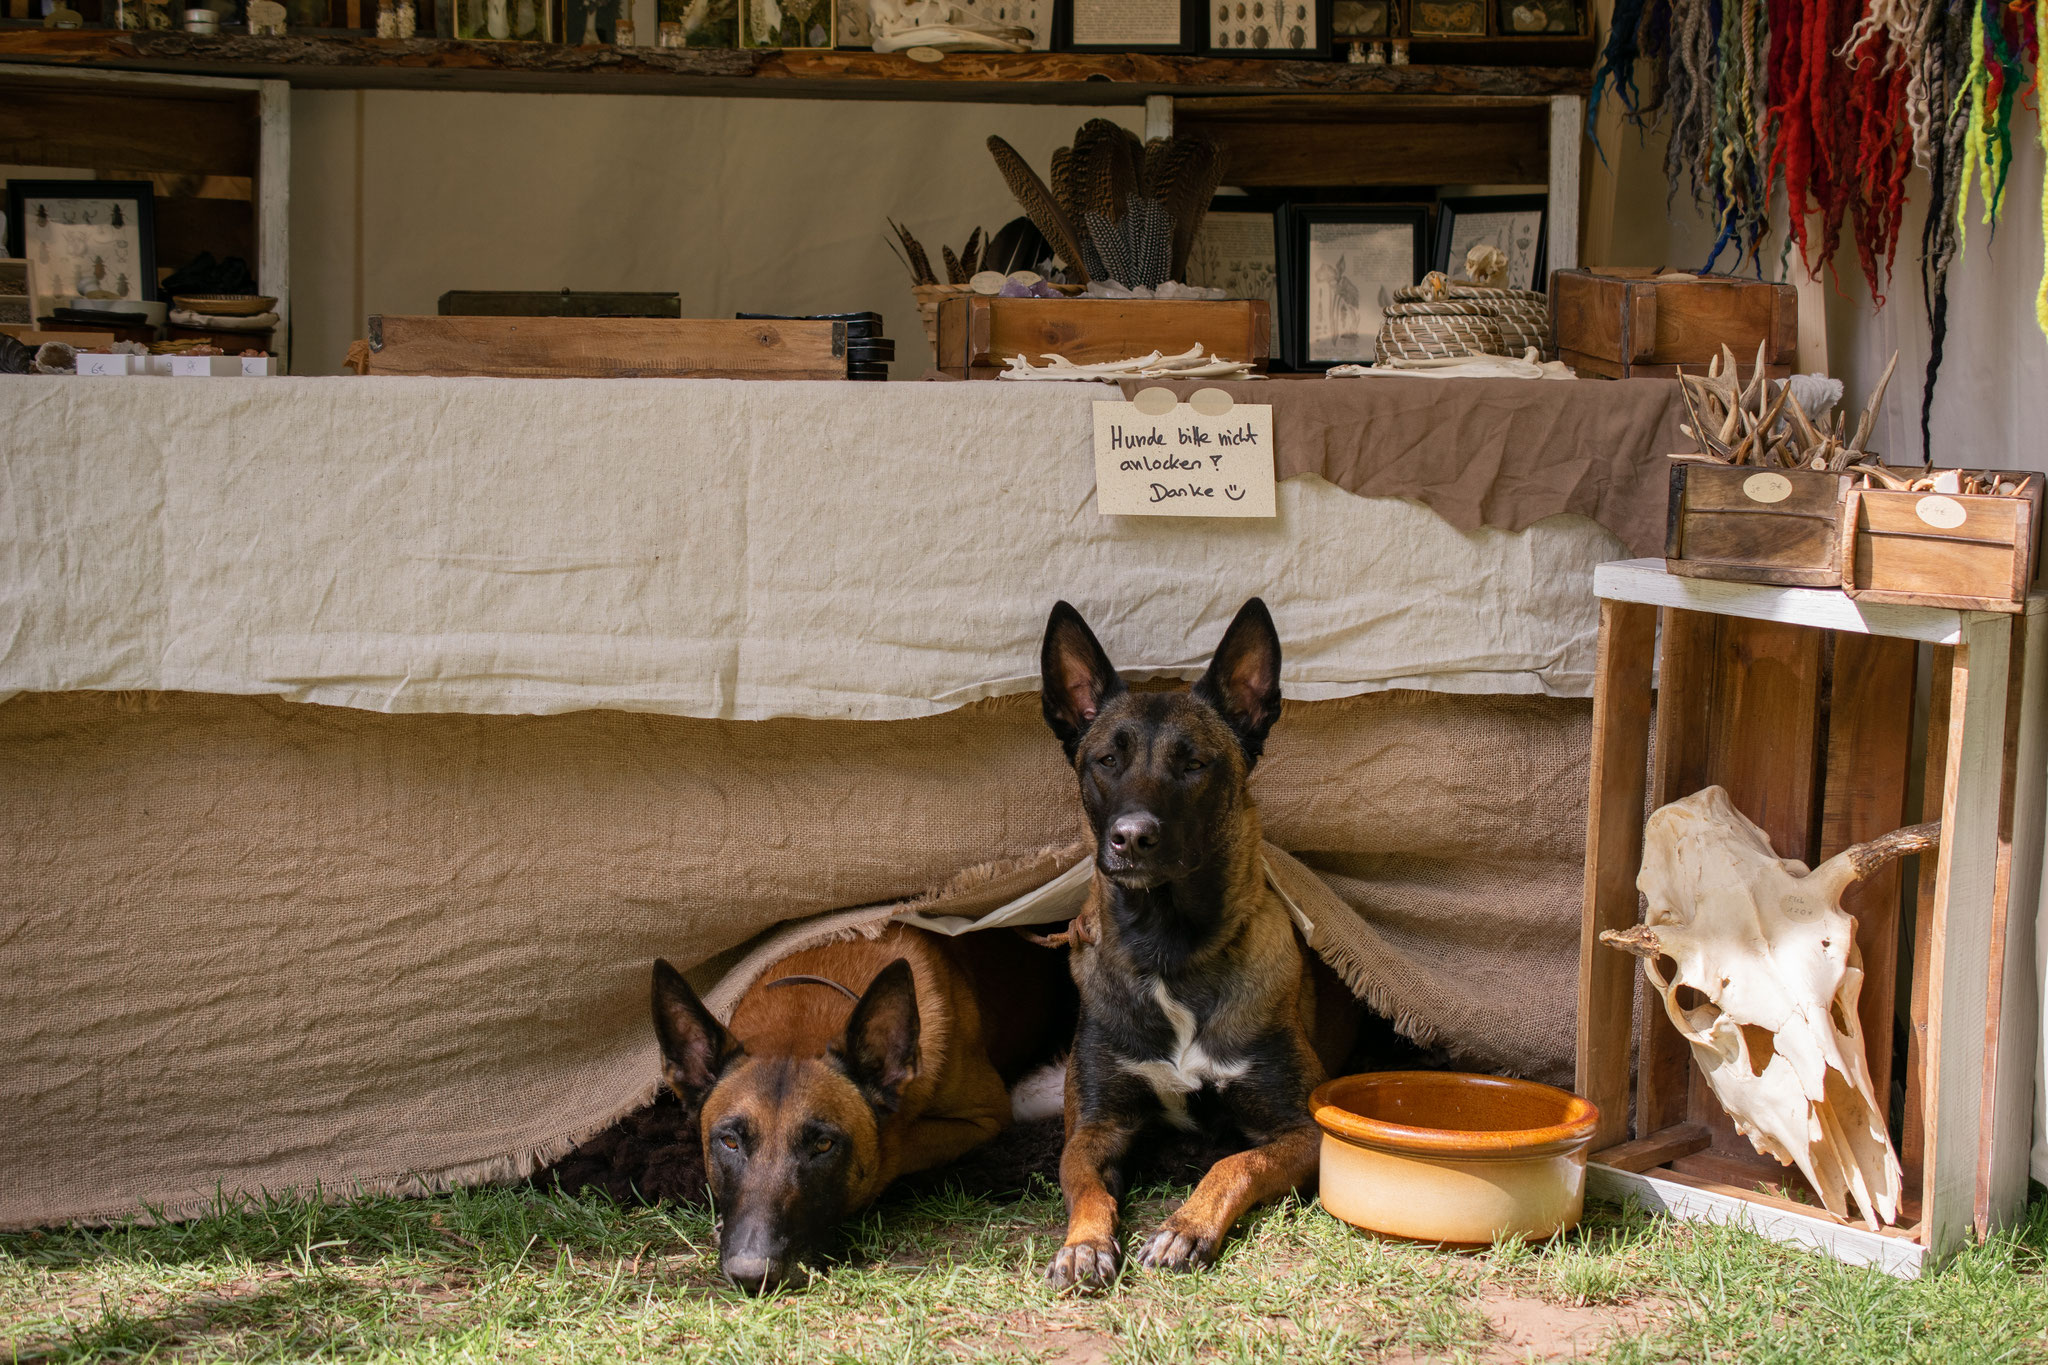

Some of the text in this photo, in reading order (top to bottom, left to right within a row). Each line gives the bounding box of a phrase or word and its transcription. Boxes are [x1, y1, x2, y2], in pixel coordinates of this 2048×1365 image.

[1111, 422, 1258, 450] Hunde bitte nicht
[1120, 454, 1202, 471] anlocken
[1150, 483, 1215, 502] Danke
